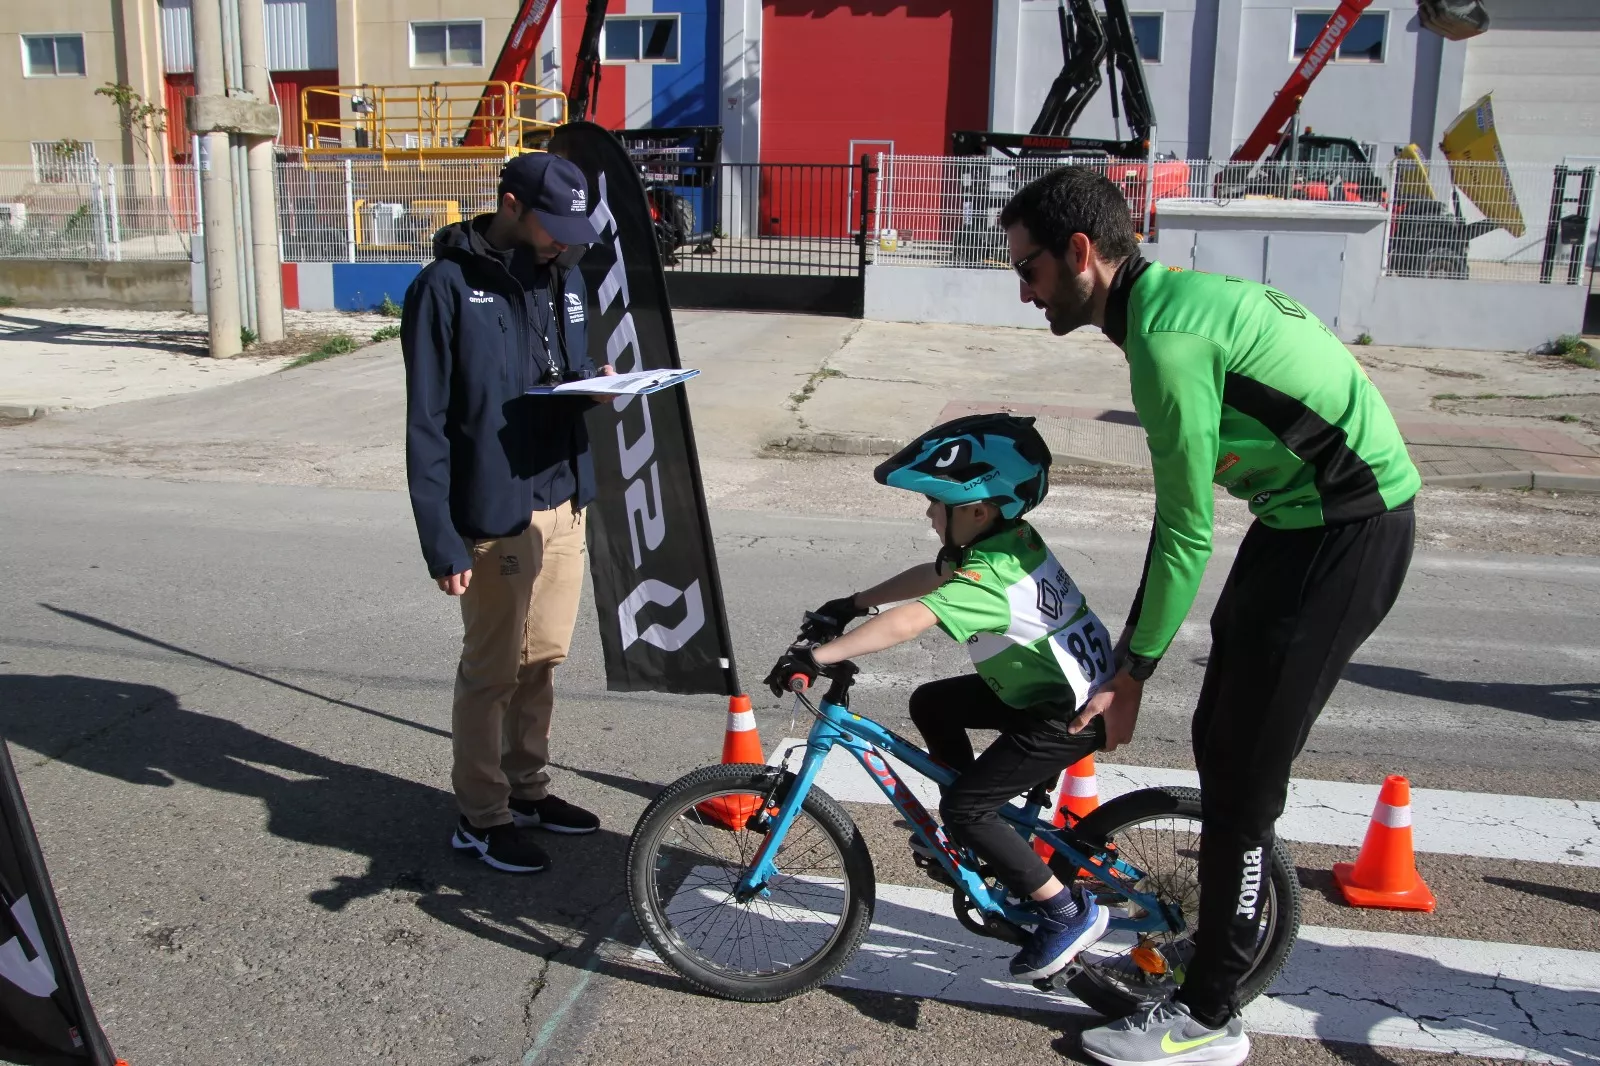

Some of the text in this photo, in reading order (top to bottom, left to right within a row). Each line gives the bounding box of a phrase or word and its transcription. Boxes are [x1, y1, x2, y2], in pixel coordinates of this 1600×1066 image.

[1299, 14, 1348, 80] MANITOU
[1022, 136, 1071, 148] MANITOU
[469, 296, 494, 304] amura
[963, 470, 1001, 491] LIXADA
[1066, 621, 1108, 684] 85
[641, 901, 677, 955] KENDA
